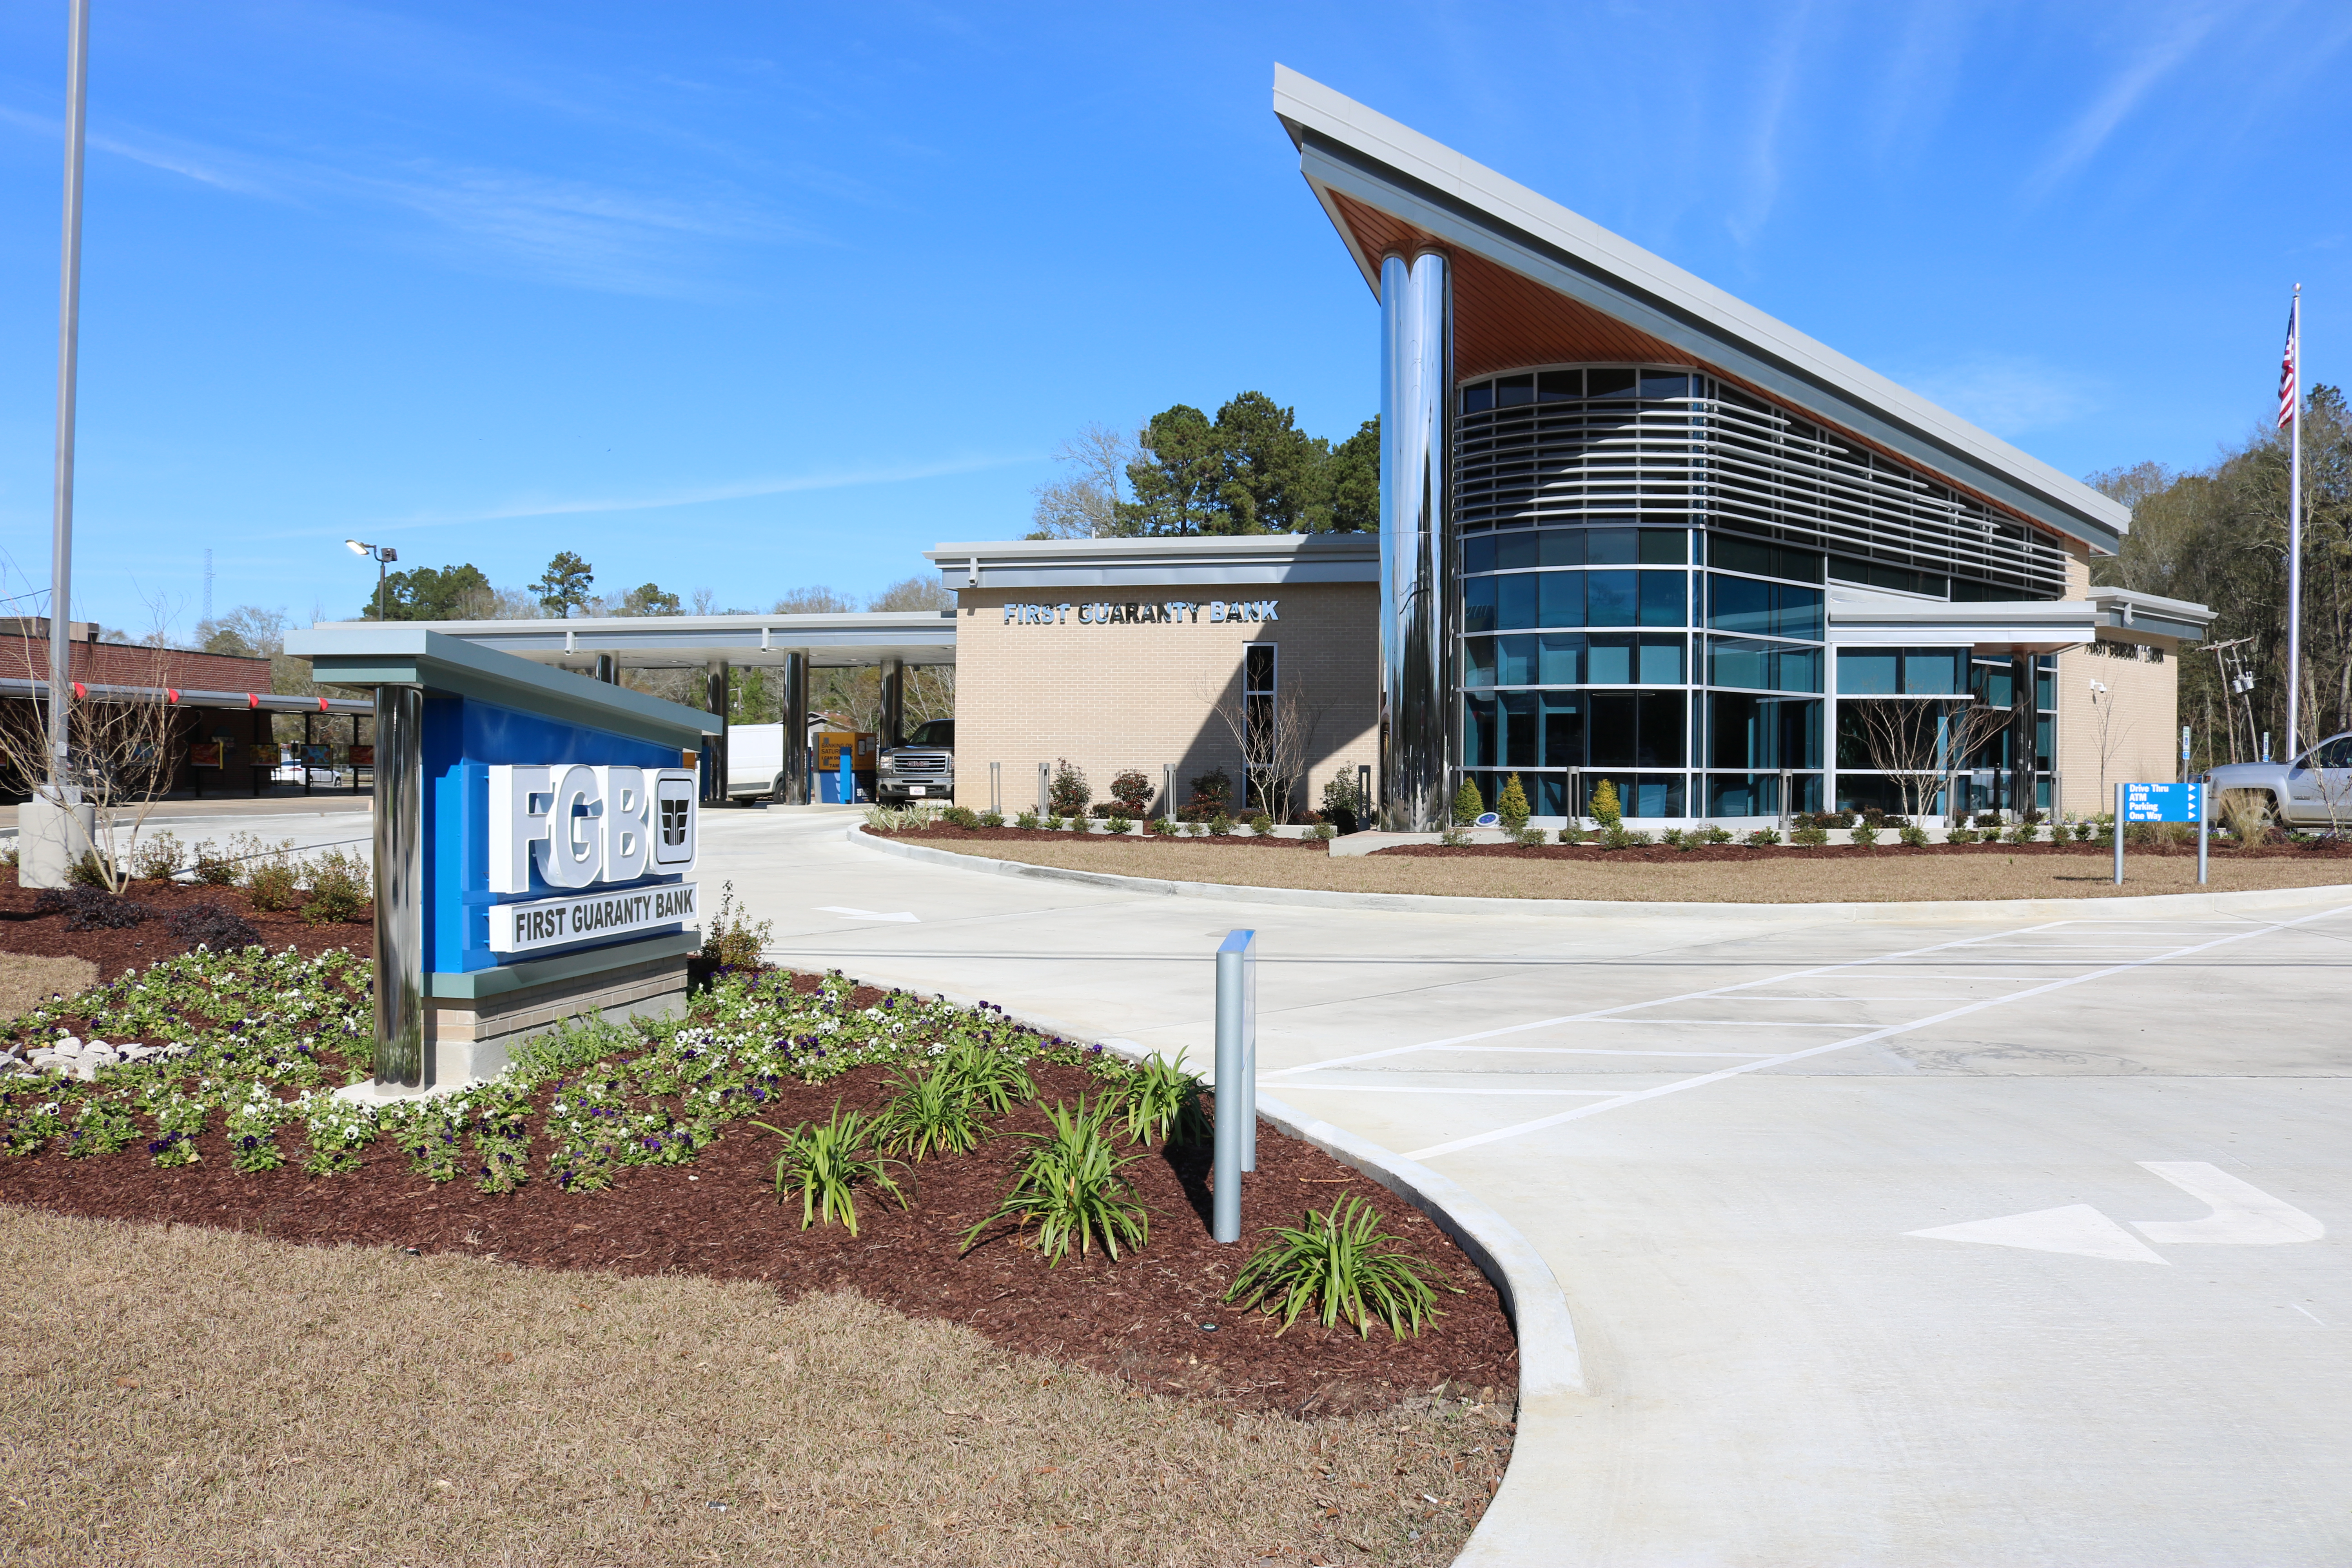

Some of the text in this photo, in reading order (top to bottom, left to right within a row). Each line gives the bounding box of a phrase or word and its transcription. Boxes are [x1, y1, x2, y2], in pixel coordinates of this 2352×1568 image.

[1004, 601, 1279, 624] FIRST GUARANTY BANK
[2129, 784, 2169, 792] Drive Thru
[2129, 793, 2147, 801] ATM
[2129, 802, 2158, 812] Parking
[2129, 811, 2162, 821] One Way
[506, 764, 648, 894] FGB
[516, 889, 693, 942] FIRST GUARANTY BANK
